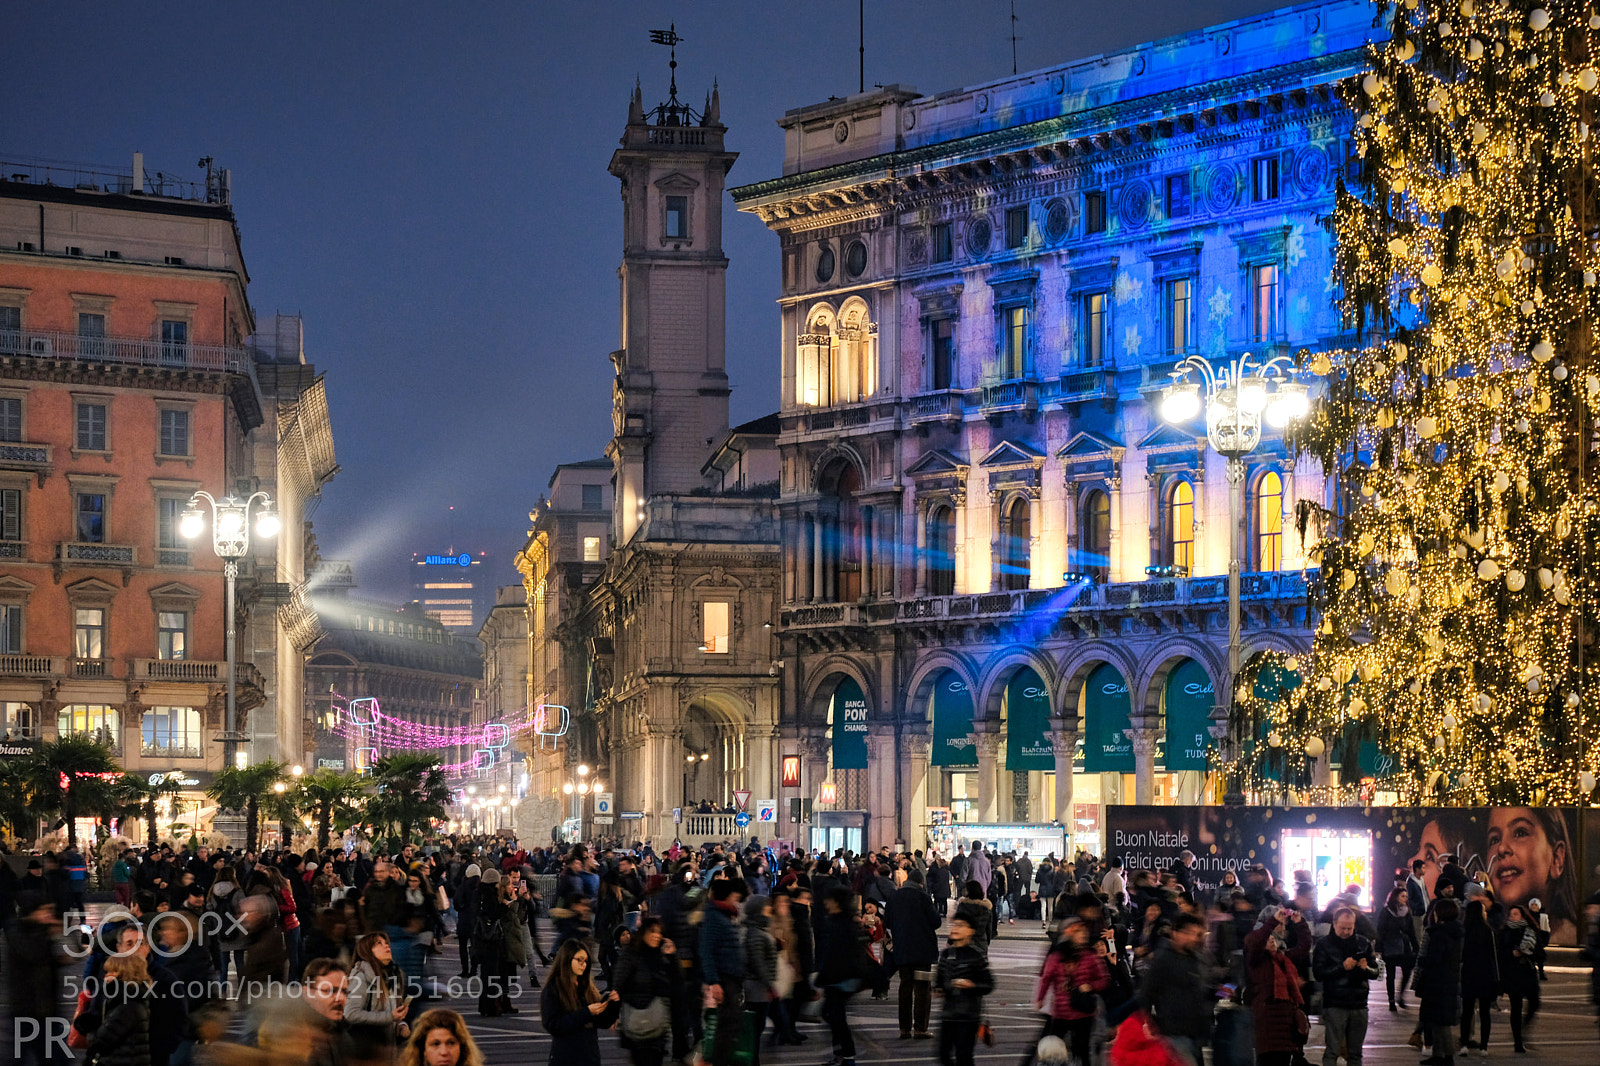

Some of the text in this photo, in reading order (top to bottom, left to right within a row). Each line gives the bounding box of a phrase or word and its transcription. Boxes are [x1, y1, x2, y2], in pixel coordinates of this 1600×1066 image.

[425, 555, 457, 565] Allianz
[844, 700, 865, 708] BANCA
[844, 708, 868, 721] PON
[783, 762, 798, 781] M
[822, 786, 836, 800] M
[1115, 830, 1189, 848] Buon Natale
[1124, 851, 1152, 869] felici
